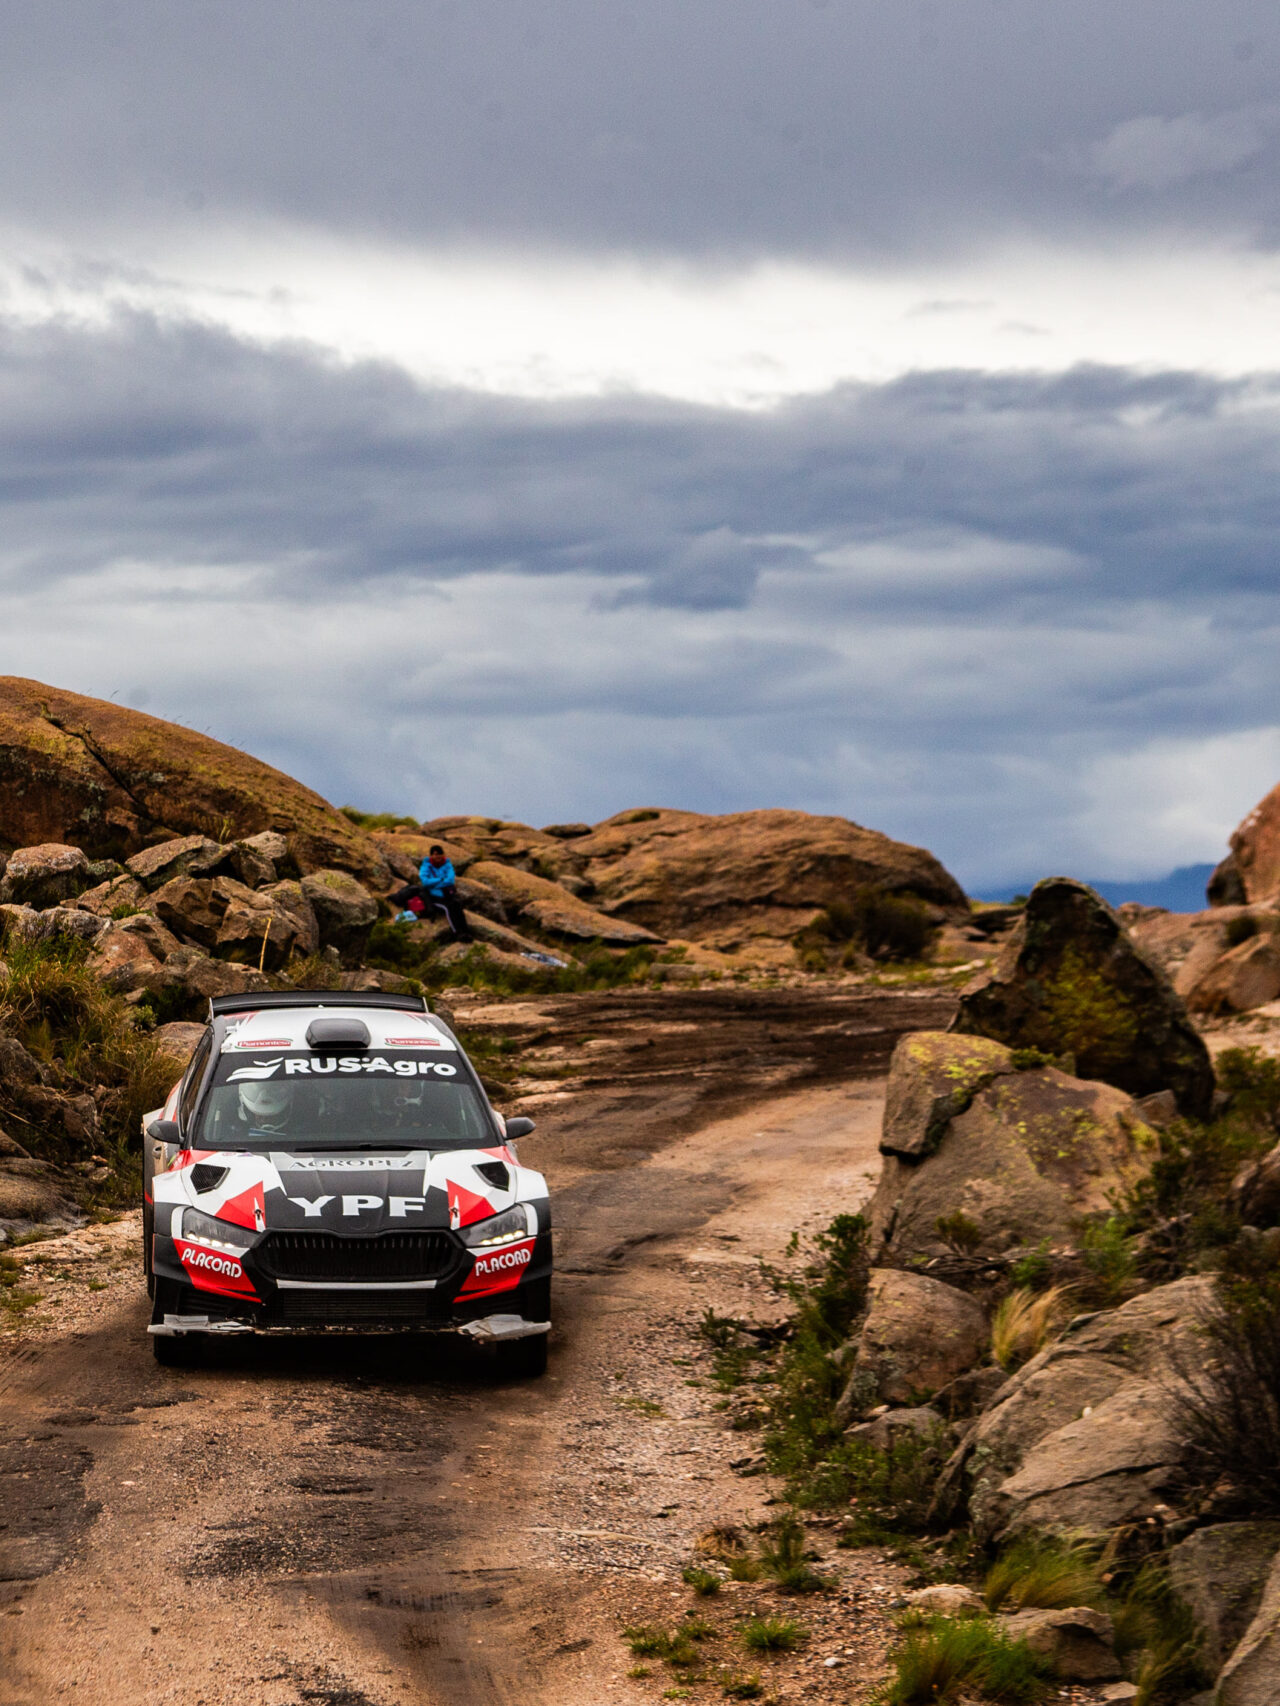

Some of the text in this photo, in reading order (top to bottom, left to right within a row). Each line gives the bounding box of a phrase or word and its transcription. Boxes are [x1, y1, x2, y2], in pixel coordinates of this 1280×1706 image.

[287, 1195, 426, 1218] YPF
[181, 1247, 242, 1278] PLACORD
[475, 1248, 531, 1277] PLACORD
